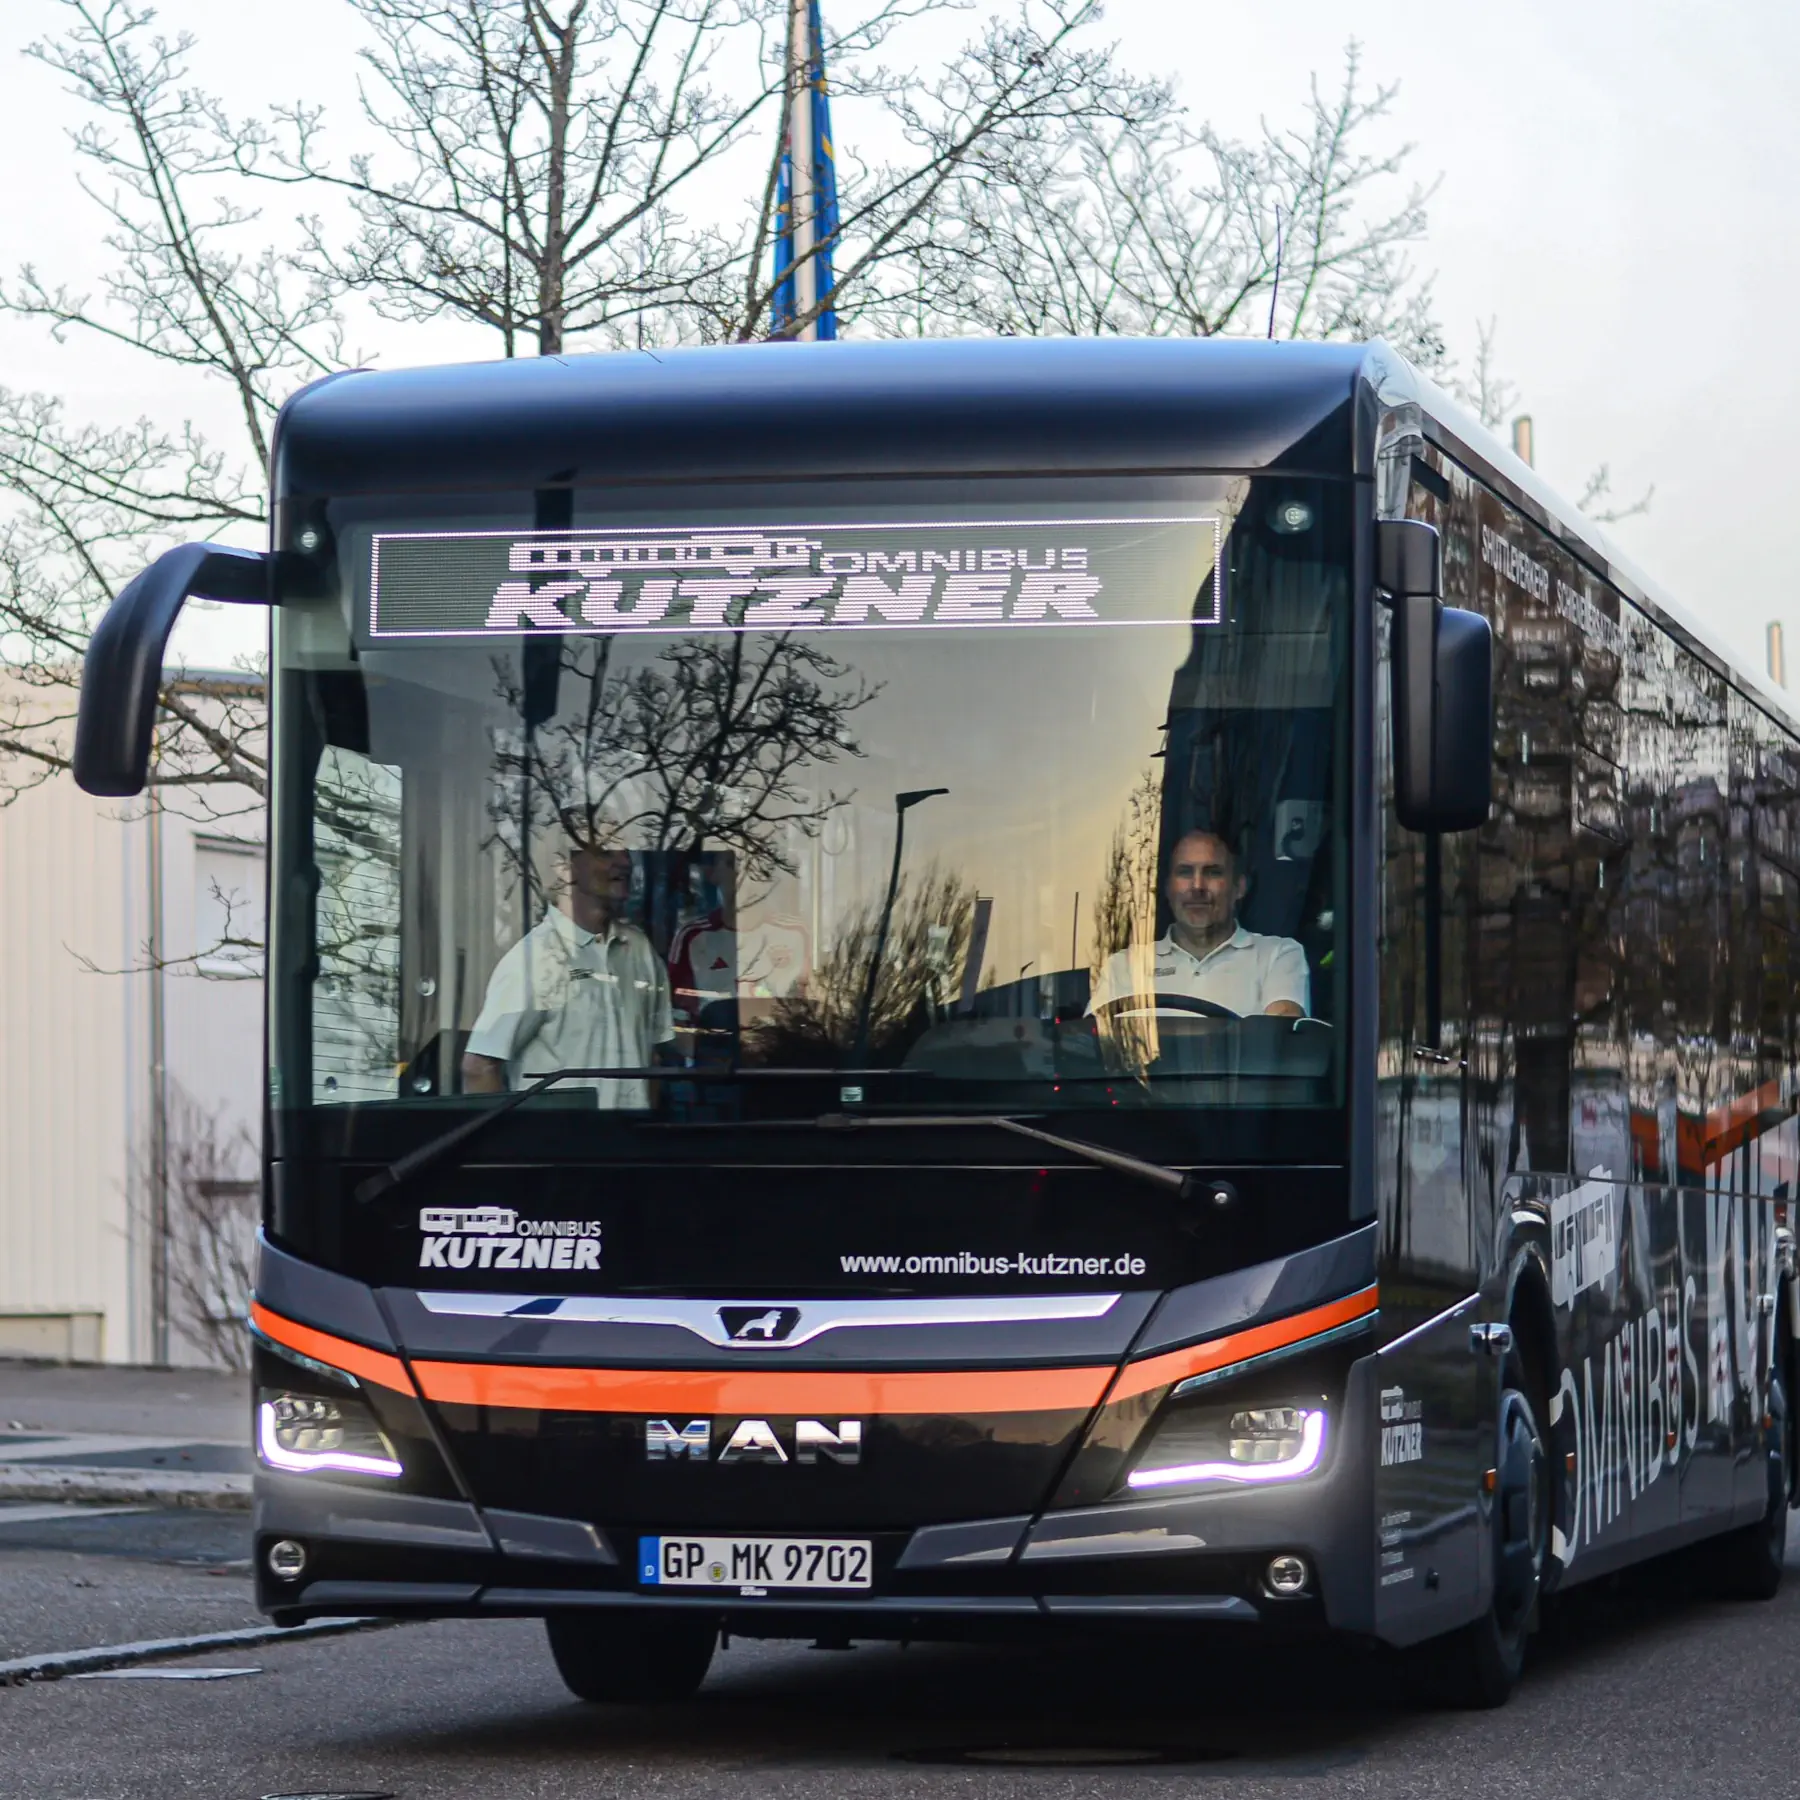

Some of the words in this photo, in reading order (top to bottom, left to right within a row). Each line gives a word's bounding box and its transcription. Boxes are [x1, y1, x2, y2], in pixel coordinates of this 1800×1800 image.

[820, 548, 1088, 573] OMNIBUS
[485, 573, 1103, 627] KUTZNER
[516, 1220, 602, 1238] OMNIBUS
[419, 1237, 602, 1270] KUTZNER
[840, 1252, 1147, 1275] www.omnibus-kutzner.de
[646, 1419, 862, 1464] MAN
[1550, 1275, 1699, 1568] OMNIBUS
[1381, 1422, 1422, 1466] KUTZNER
[663, 1542, 705, 1578] GP
[731, 1543, 773, 1580] MK
[784, 1545, 868, 1582] 9702
